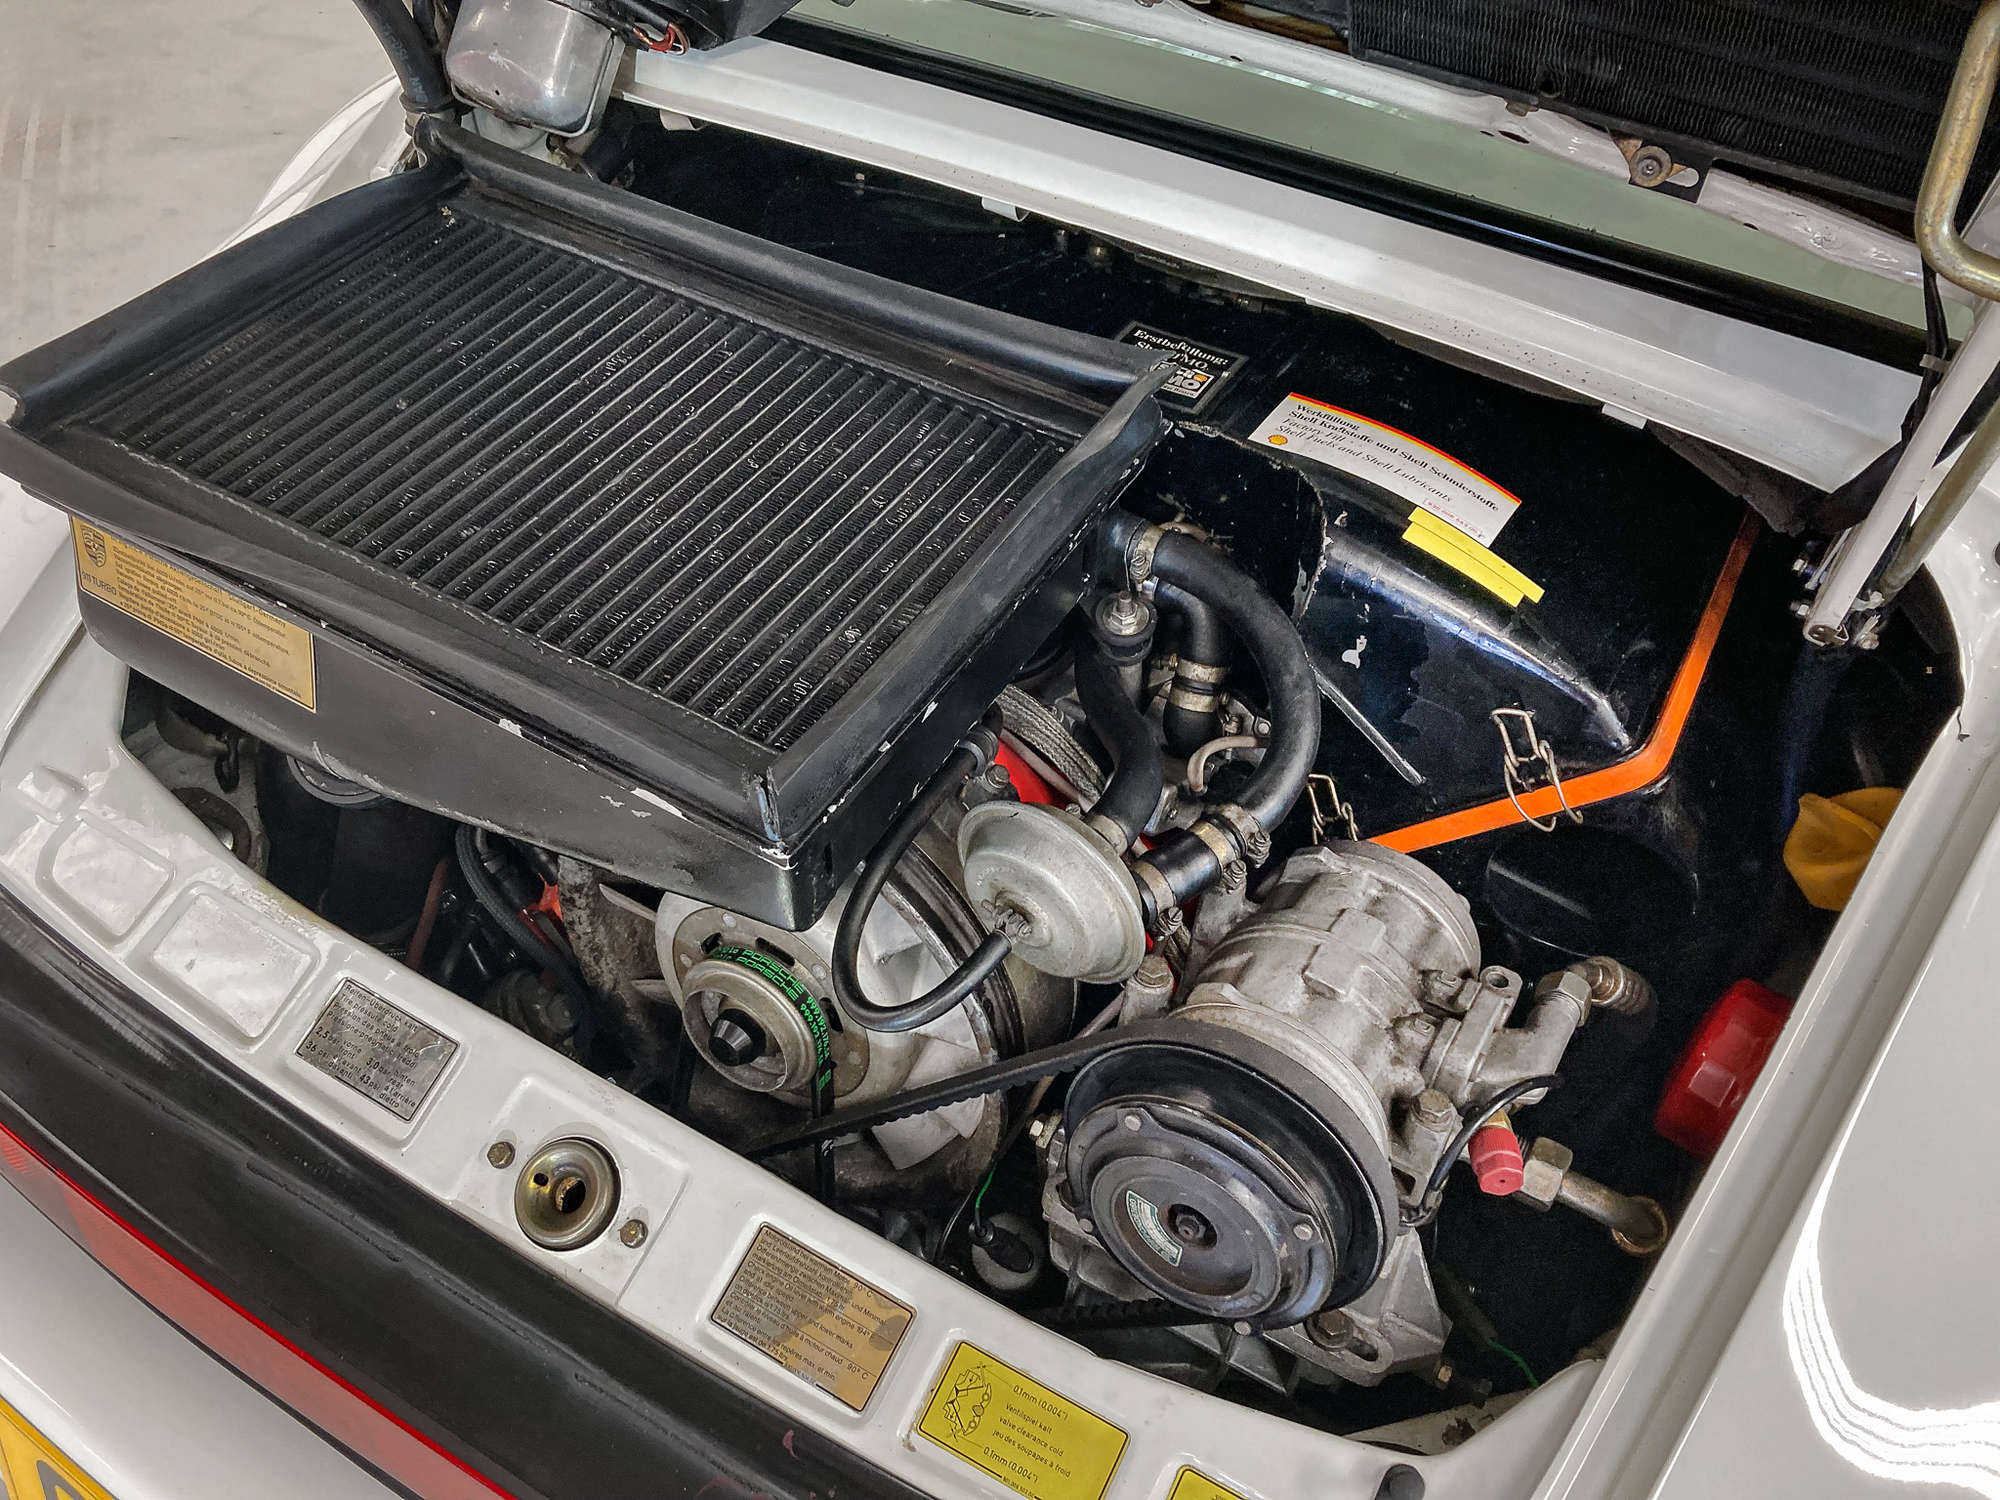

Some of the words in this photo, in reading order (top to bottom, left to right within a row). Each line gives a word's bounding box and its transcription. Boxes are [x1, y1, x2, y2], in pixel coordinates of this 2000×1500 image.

[1283, 419, 1323, 435] Factory
[1326, 432, 1347, 442] Fill
[1297, 404, 1360, 431] Werkfüllung
[1279, 425, 1306, 438] Shell
[1307, 435, 1336, 448] Fuels
[1338, 446, 1363, 457] and
[1362, 455, 1394, 470] Shell
[1393, 469, 1450, 502] Lubricants
[1289, 411, 1318, 424] Shell
[1320, 420, 1374, 444] Kraftstoffe
[1376, 442, 1398, 453] und
[1400, 451, 1428, 468] Shell
[1429, 466, 1499, 511] Schmierstoffe
[736, 956, 799, 1001] PORSCHE
[742, 949, 805, 994] PORSCHE
[340, 993, 353, 1005] Tire
[382, 1020, 398, 1032] cold
[305, 1040, 317, 1052] 36
[343, 1039, 361, 1053] vorne
[365, 1057, 379, 1069] 3,0
[359, 1073, 370, 1084] 43
[388, 1077, 403, 1089] rear
[378, 1092, 399, 1108] dietro
[743, 1268, 756, 1278] and
[734, 1283, 742, 1292] on
[866, 1288, 874, 1297] C
[765, 1291, 790, 1311] between
[789, 1307, 808, 1320] upper
[809, 1318, 819, 1328] and
[818, 1323, 835, 1337] lower
[851, 1302, 863, 1312] und
[715, 1314, 727, 1325] sur
[725, 1319, 732, 1327] la
[731, 1322, 748, 1339] jauge
[747, 1334, 758, 1344] est
[757, 1339, 766, 1349] de
[835, 1313, 854, 1329] engine
[755, 1327, 771, 1341] entre
[817, 1366, 824, 1374] et
[803, 1337, 824, 1352] moteur
[824, 1350, 843, 1364] chaud
[861, 1371, 868, 1379] C
[1006, 1403, 1038, 1425] Ventilspiel
[1038, 1422, 1052, 1434] kalt
[999, 1416, 1016, 1430] valve
[1016, 1427, 1048, 1447] clearance
[1048, 1446, 1064, 1456] cold
[992, 1430, 1004, 1439] jeu
[1003, 1435, 1015, 1446] des
[1017, 1443, 1048, 1464] soupapes
[1054, 1463, 1070, 1477] froid
